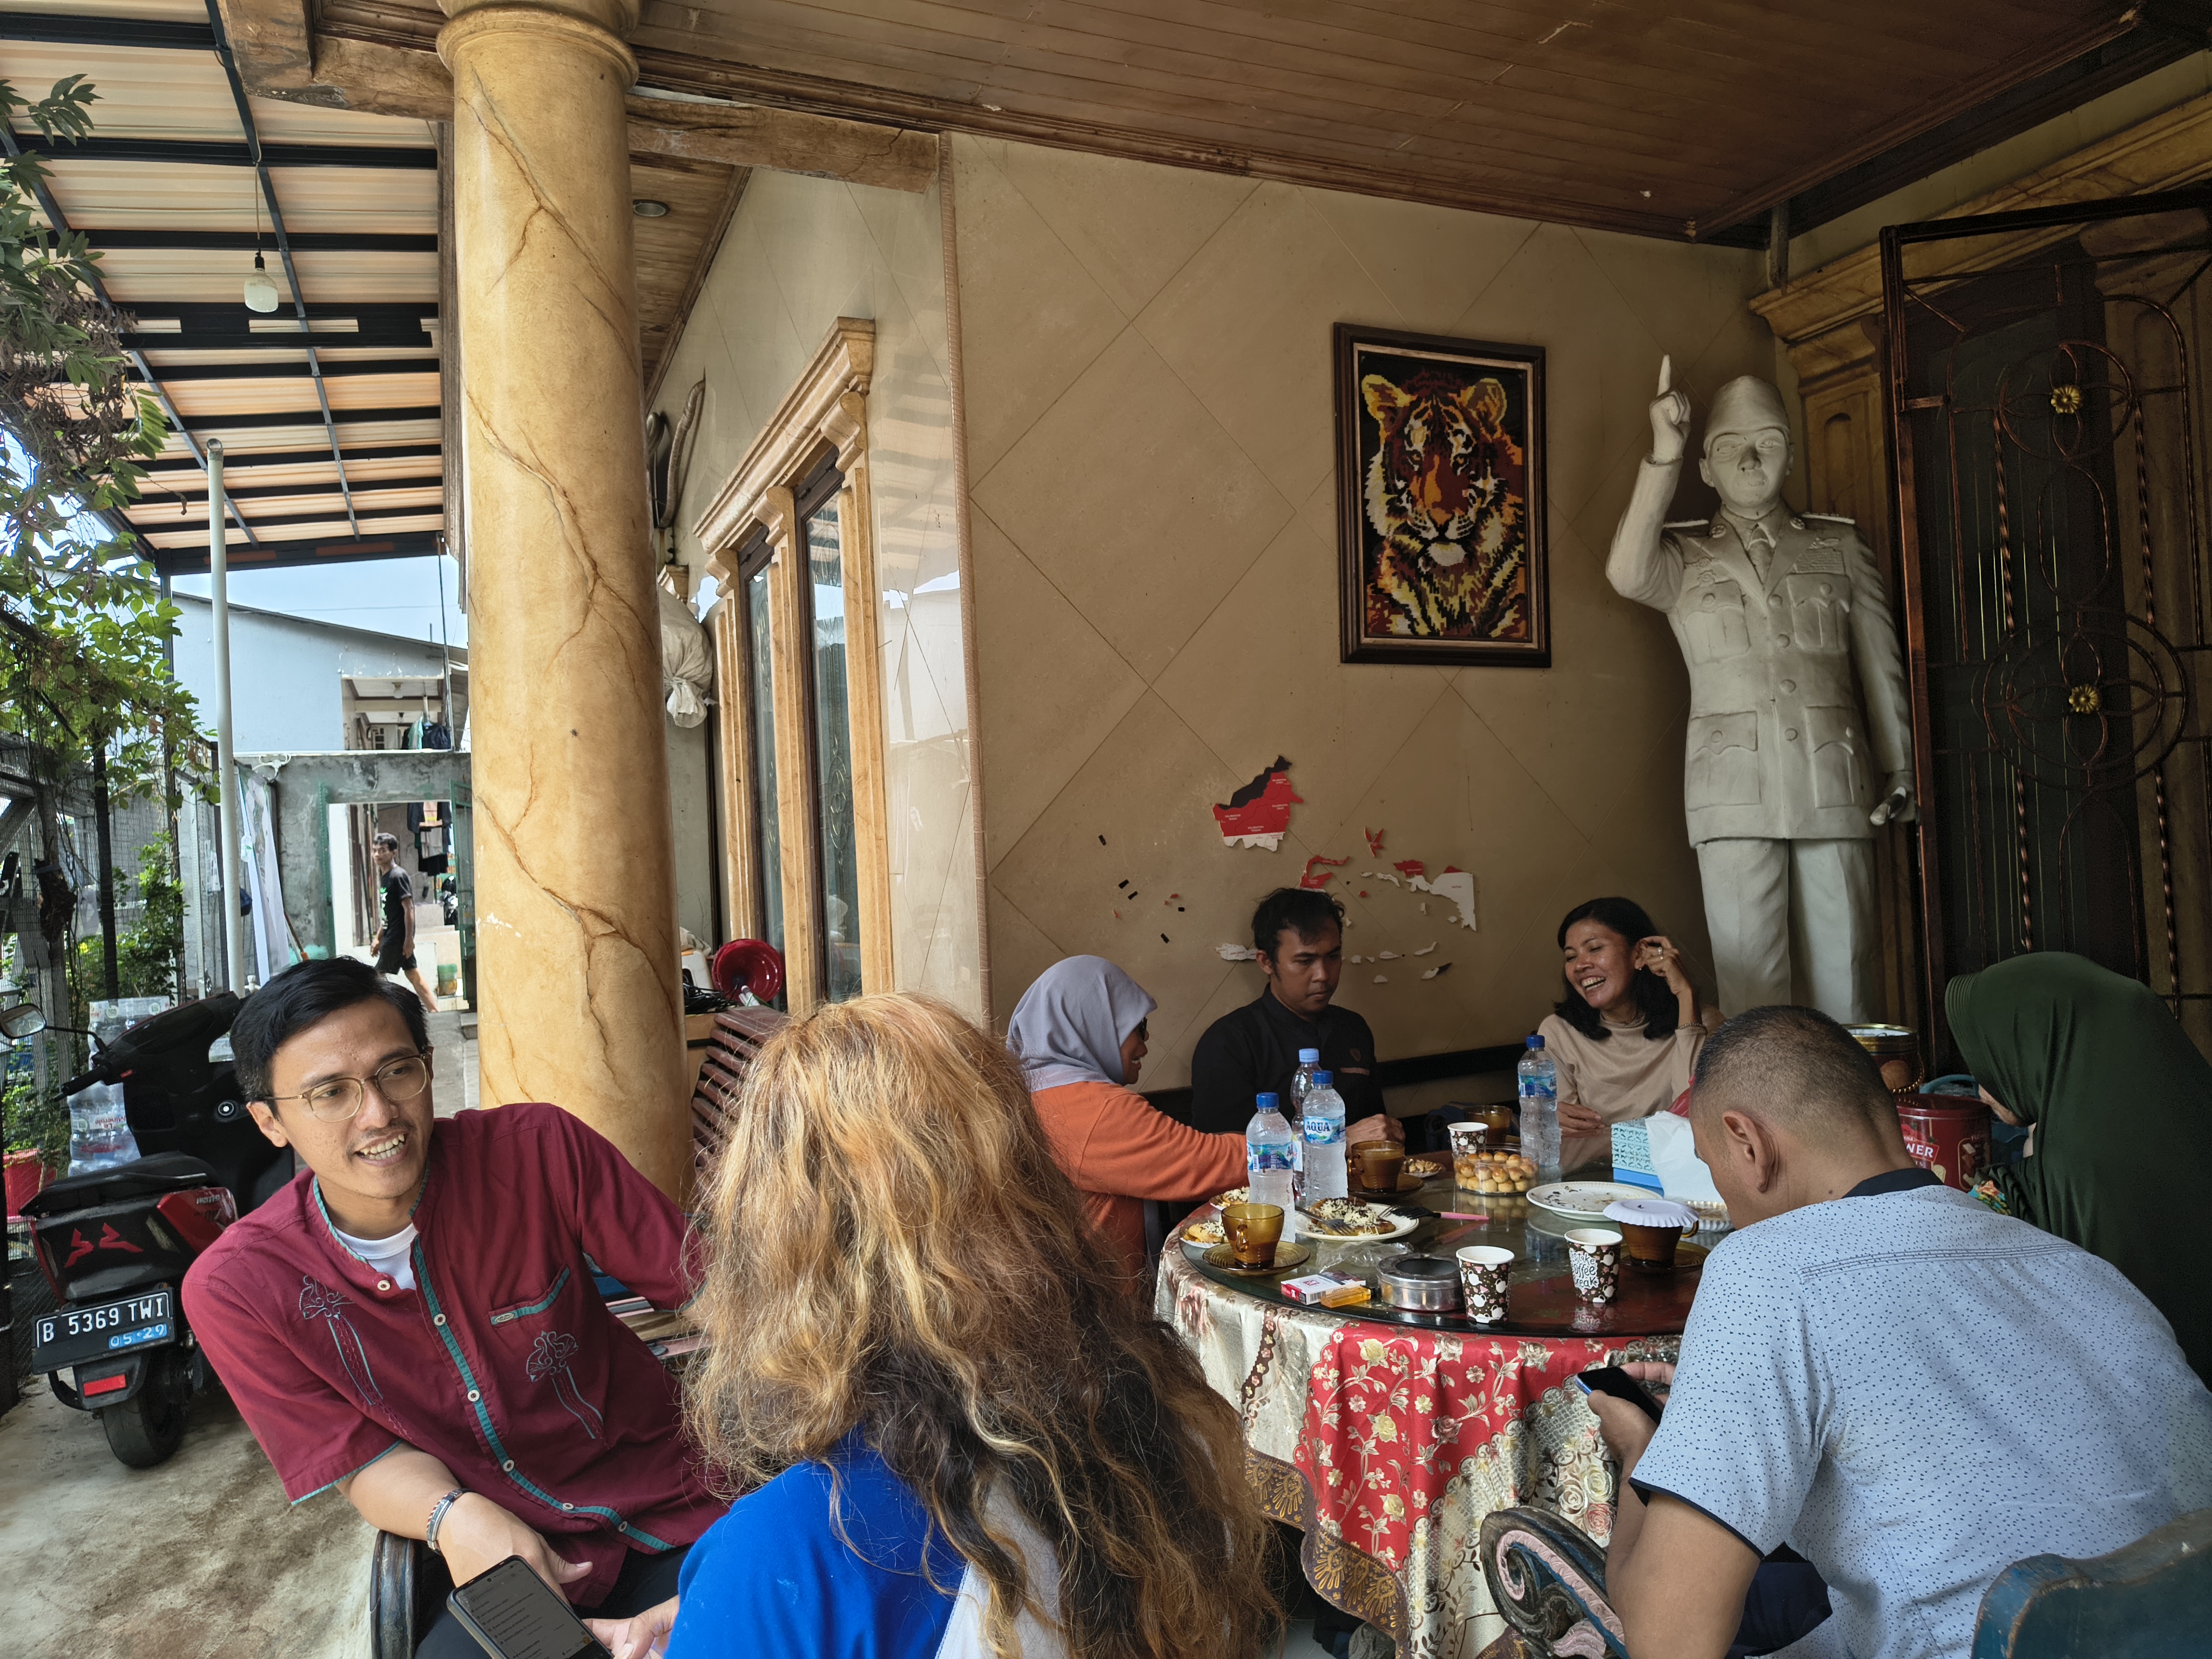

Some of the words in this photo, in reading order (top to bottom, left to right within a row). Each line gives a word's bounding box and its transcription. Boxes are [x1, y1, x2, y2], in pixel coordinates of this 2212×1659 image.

[1306, 1121, 1330, 1133] AQUA
[1906, 1143, 1933, 1158] WER
[1577, 1253, 1595, 1265] take
[43, 1322, 55, 1343] B
[68, 1307, 119, 1336] 5369
[127, 1297, 164, 1321] TWI
